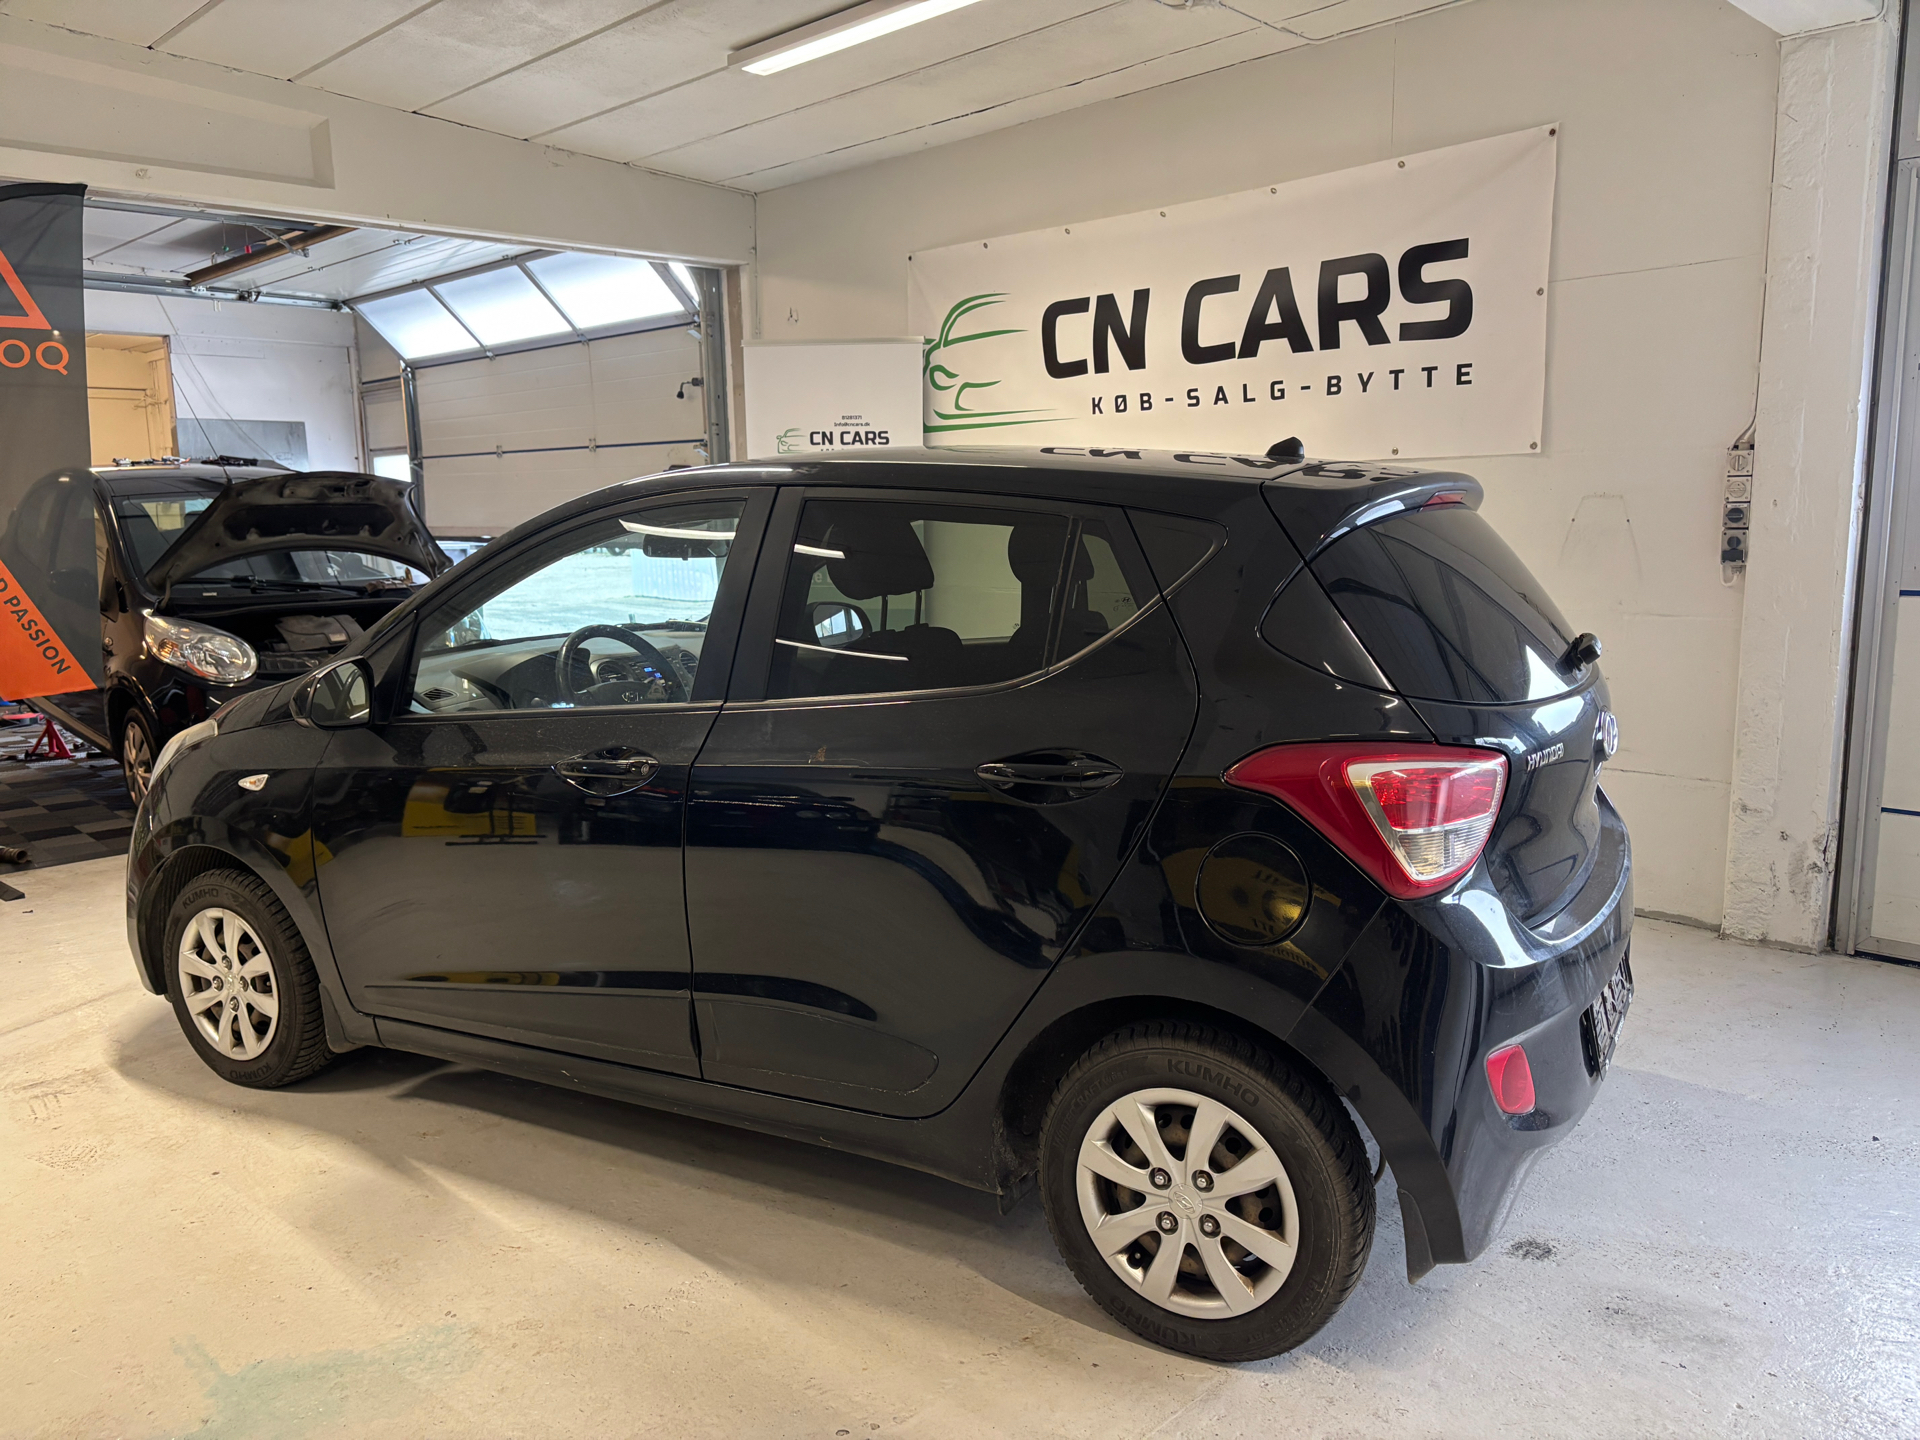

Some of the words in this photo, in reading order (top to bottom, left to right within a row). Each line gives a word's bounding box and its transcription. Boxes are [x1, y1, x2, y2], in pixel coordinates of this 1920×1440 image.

[1042, 288, 1150, 379] CN
[1181, 238, 1473, 365] CARS
[809, 431, 834, 446] CN
[840, 430, 890, 446] CARS
[3, 595, 71, 675] PASSION
[1527, 742, 1565, 773] HYUNDAI
[182, 888, 219, 909] KUMHO
[229, 1062, 272, 1080] KUMHO
[1167, 1058, 1260, 1109] KUMHO
[1110, 1299, 1198, 1347] KUMHO
